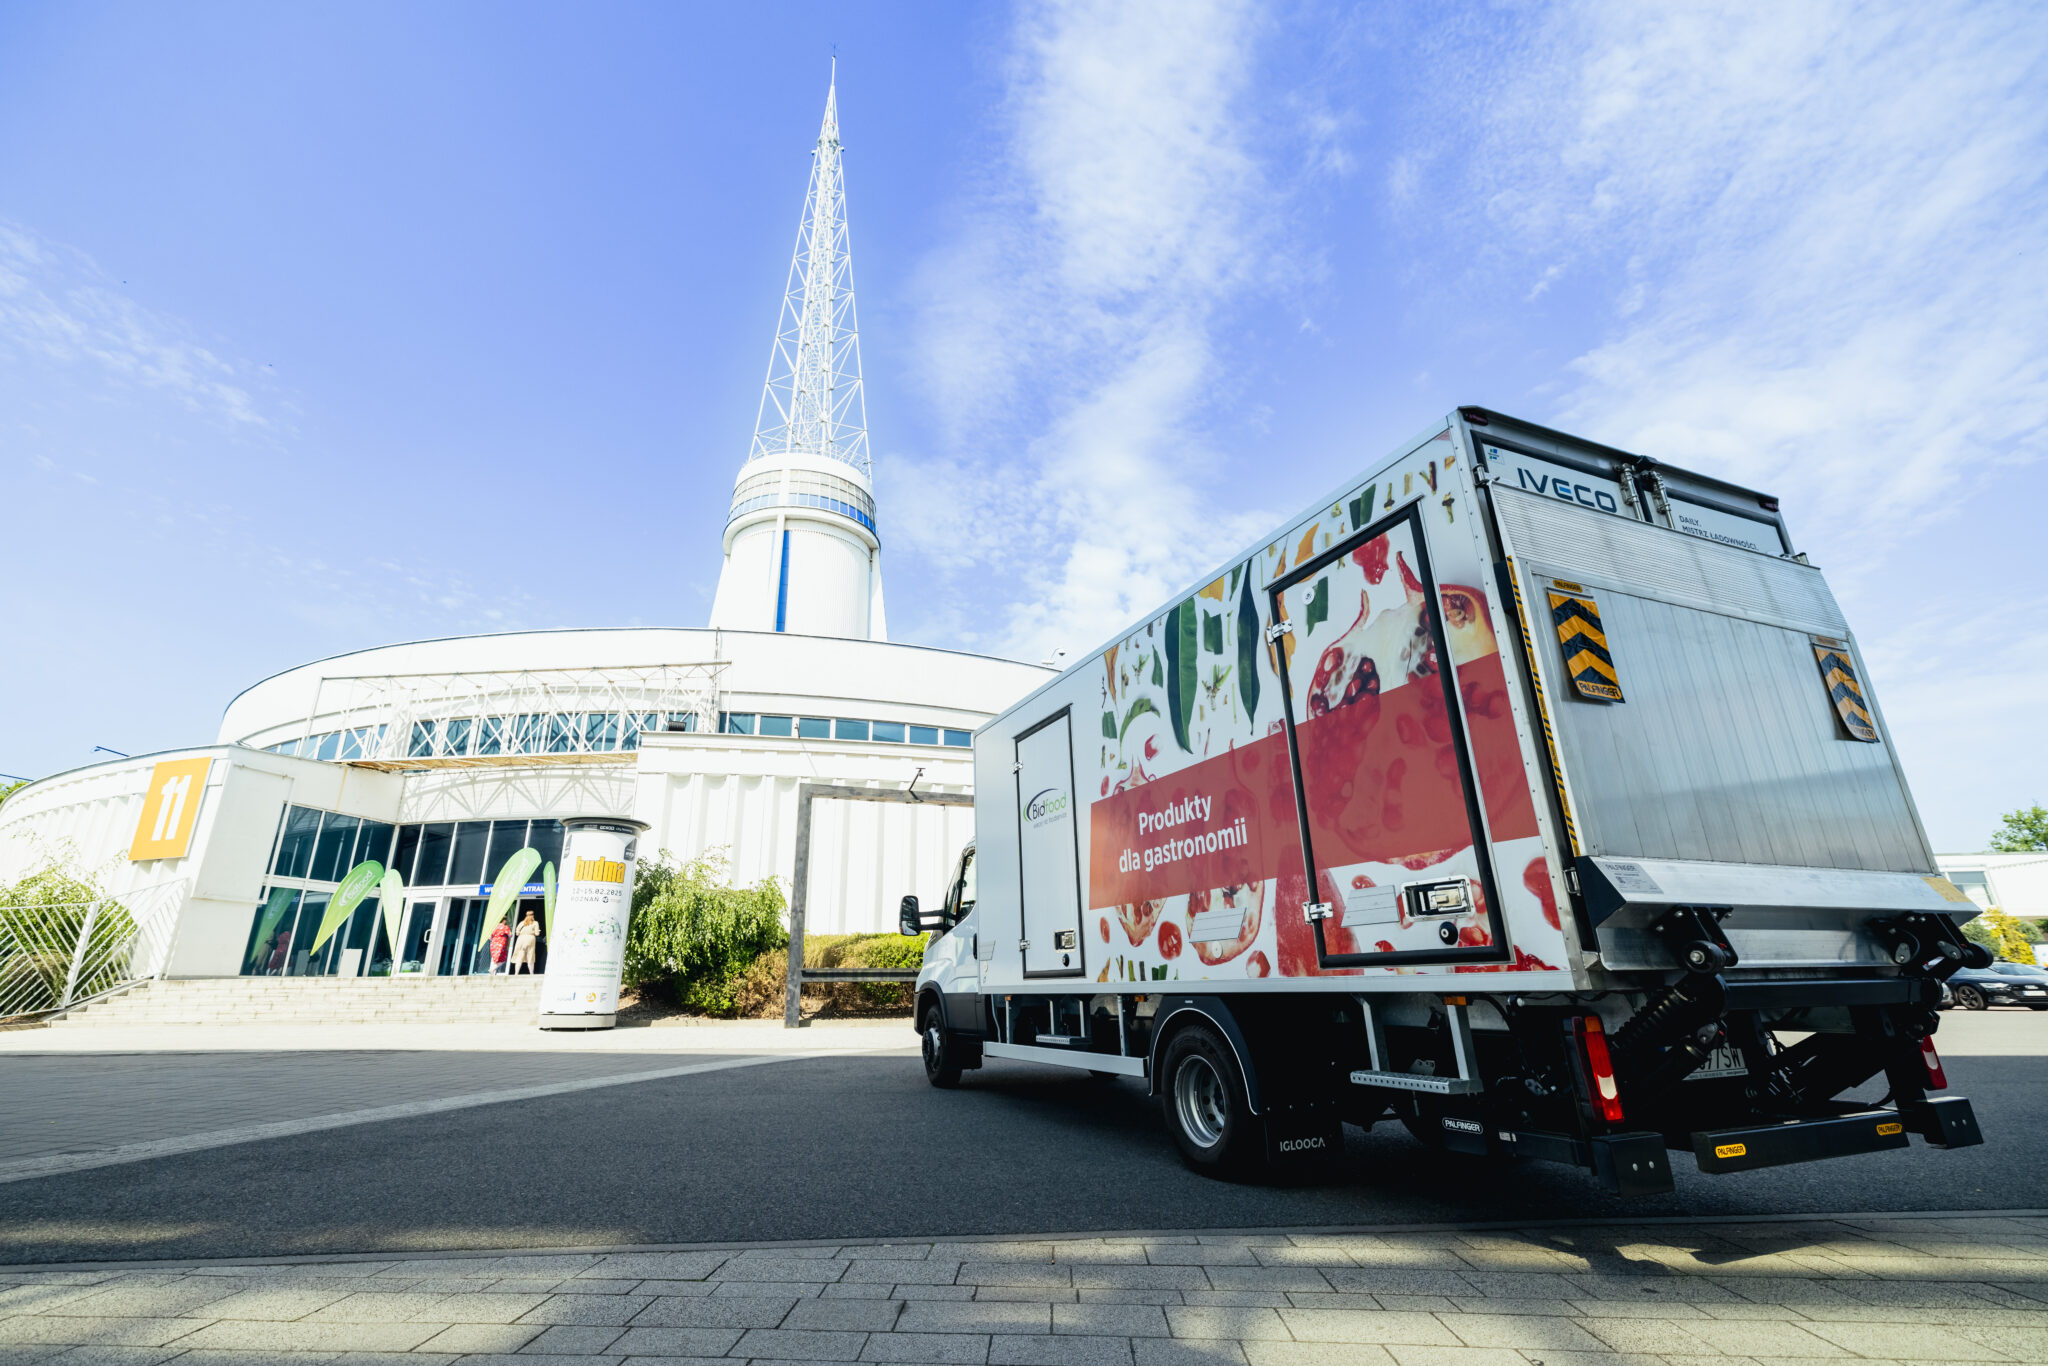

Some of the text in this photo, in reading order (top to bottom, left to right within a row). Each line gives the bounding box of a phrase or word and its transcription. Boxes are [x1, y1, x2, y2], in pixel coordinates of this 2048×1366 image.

[1517, 467, 1617, 513] IVECO
[1682, 525, 1709, 538] MISTRZ
[1555, 581, 1582, 592] PALFINGER
[1579, 682, 1620, 698] PALFINGER
[152, 775, 191, 841] 11
[1032, 792, 1066, 820] Bidfood
[1138, 795, 1212, 836] Produkty
[1119, 817, 1248, 873] dla gastronomii
[574, 856, 626, 884] budma
[1444, 1119, 1480, 1132] PALFINGER
[1279, 1137, 1326, 1152] IGLOOCA
[1717, 1145, 1745, 1156] PALFINGER
